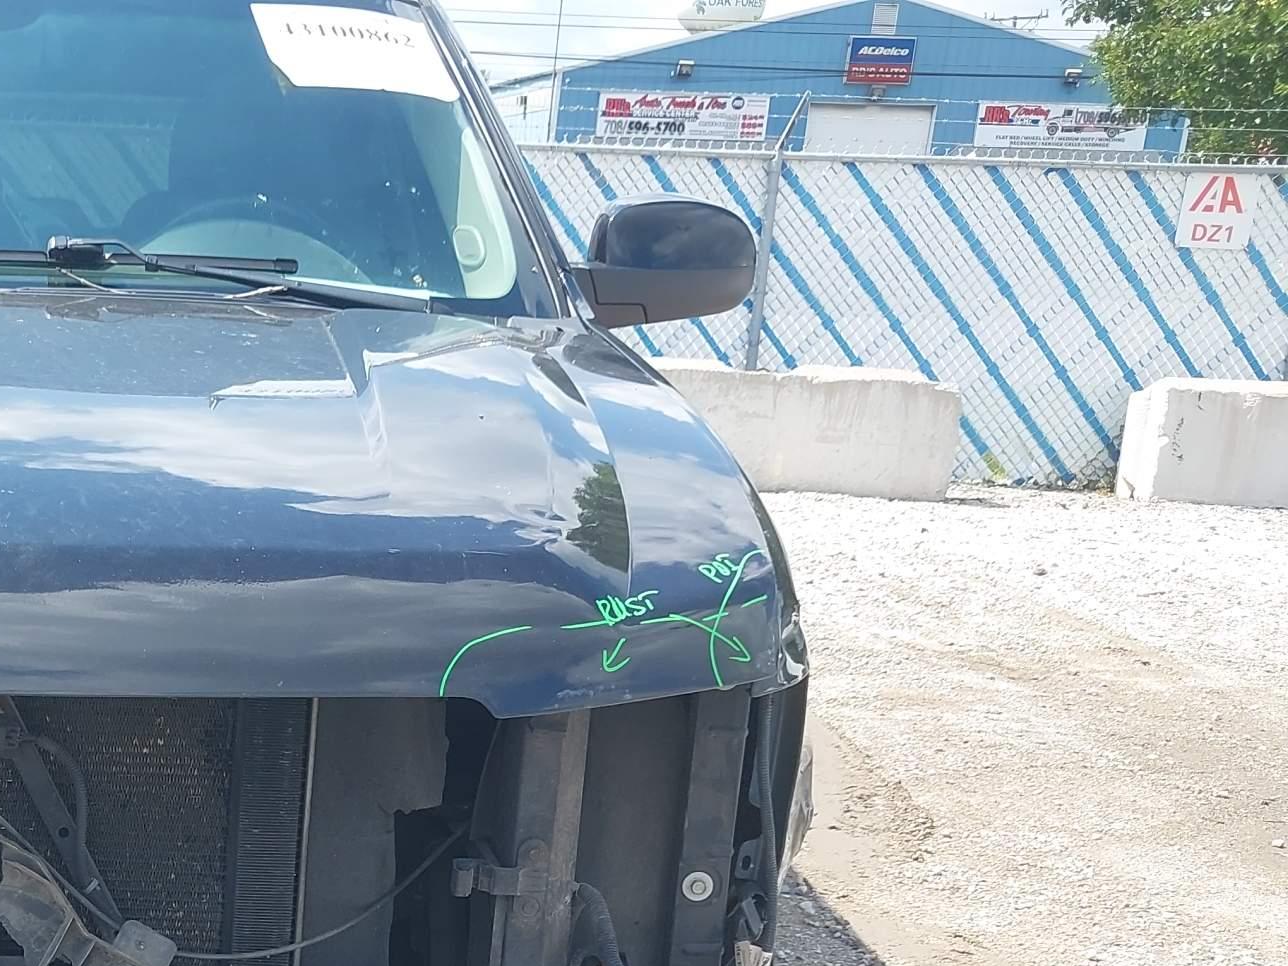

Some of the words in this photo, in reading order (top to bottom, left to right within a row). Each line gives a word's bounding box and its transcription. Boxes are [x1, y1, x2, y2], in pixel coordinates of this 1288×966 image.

[858, 46, 910, 56] ACDelco
[1191, 224, 1234, 243] DZ1
[595, 590, 660, 626] RUST
